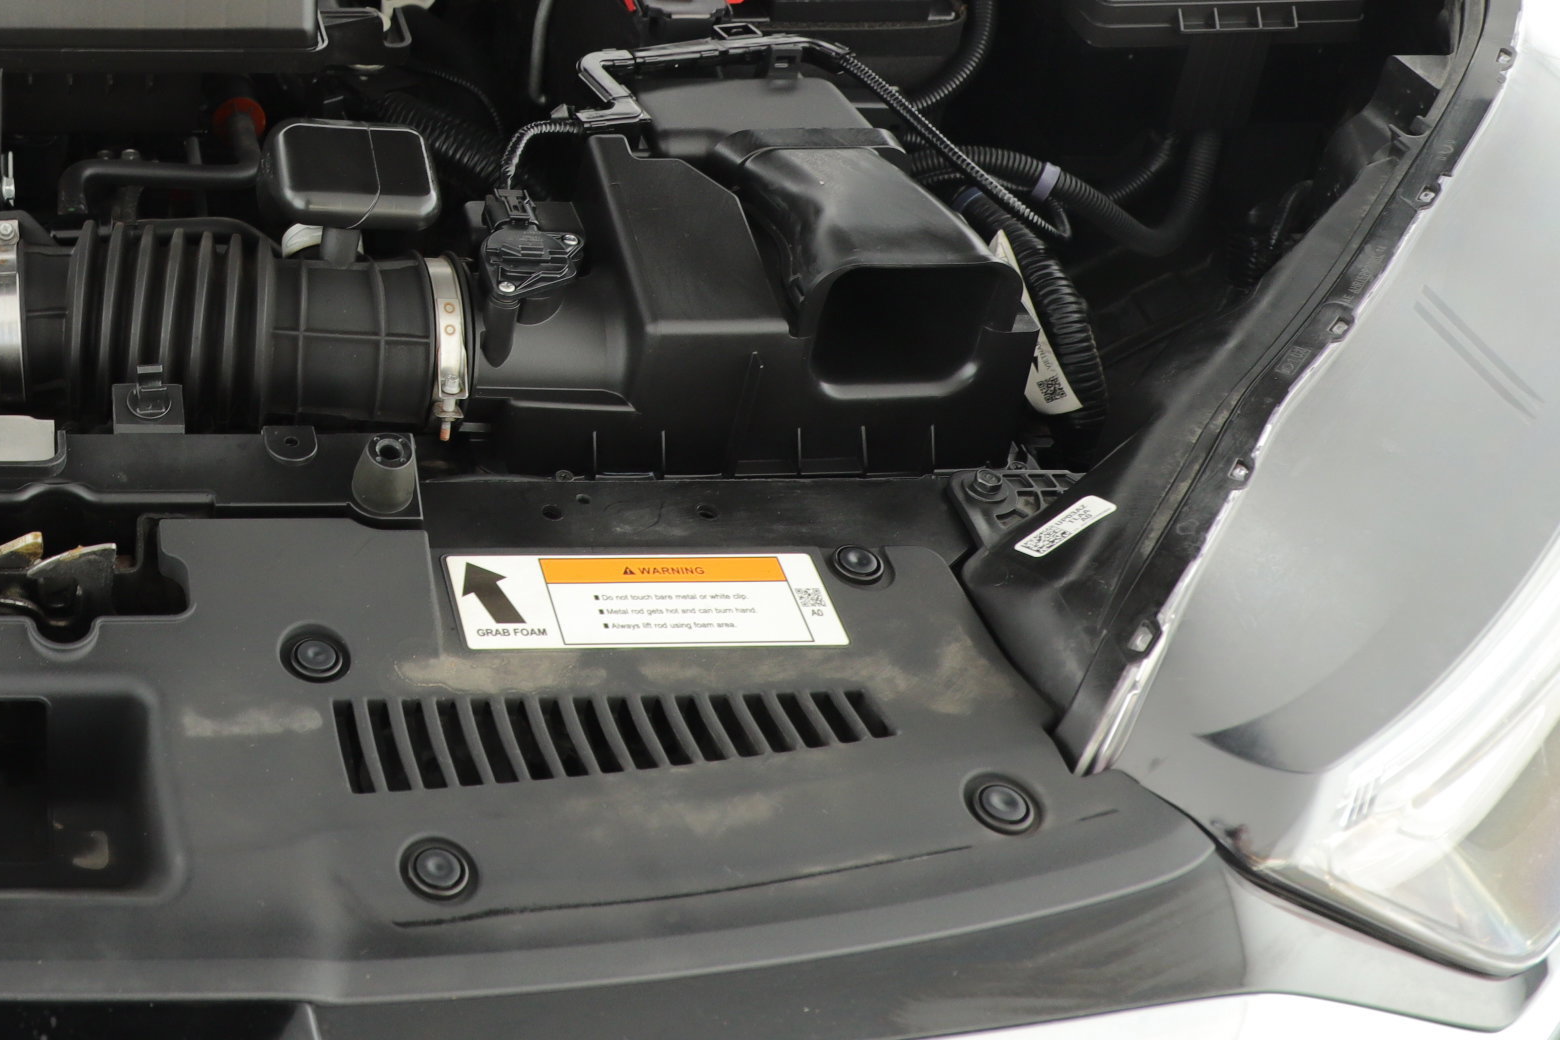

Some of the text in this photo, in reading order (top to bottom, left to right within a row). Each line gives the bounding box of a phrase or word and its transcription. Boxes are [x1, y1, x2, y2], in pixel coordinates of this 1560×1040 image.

[638, 566, 705, 575] WARNING
[477, 629, 548, 637] GRAB FOAM
